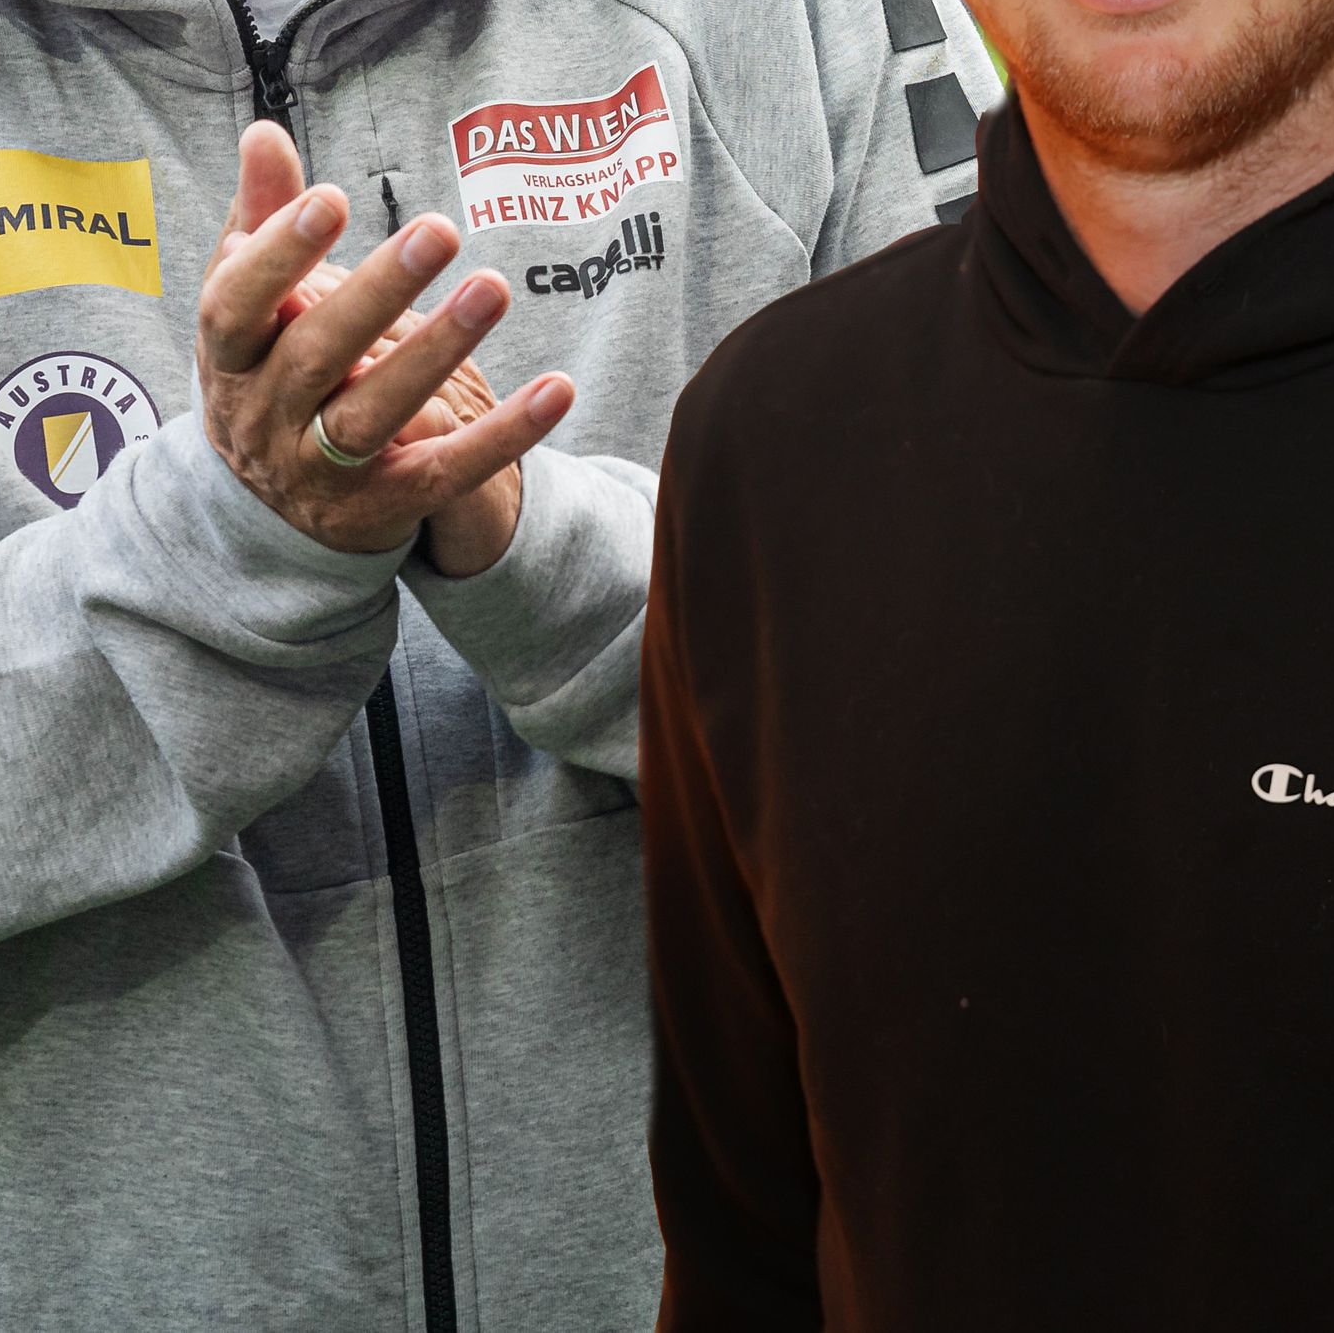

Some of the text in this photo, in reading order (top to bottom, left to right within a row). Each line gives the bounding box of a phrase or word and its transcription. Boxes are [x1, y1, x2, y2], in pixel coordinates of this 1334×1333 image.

[467, 92, 640, 161] DAS WIEN
[470, 151, 678, 228] HEINZ KNAPP
[523, 157, 624, 188] VERLAGSHAUS
[526, 211, 665, 299] capelli
